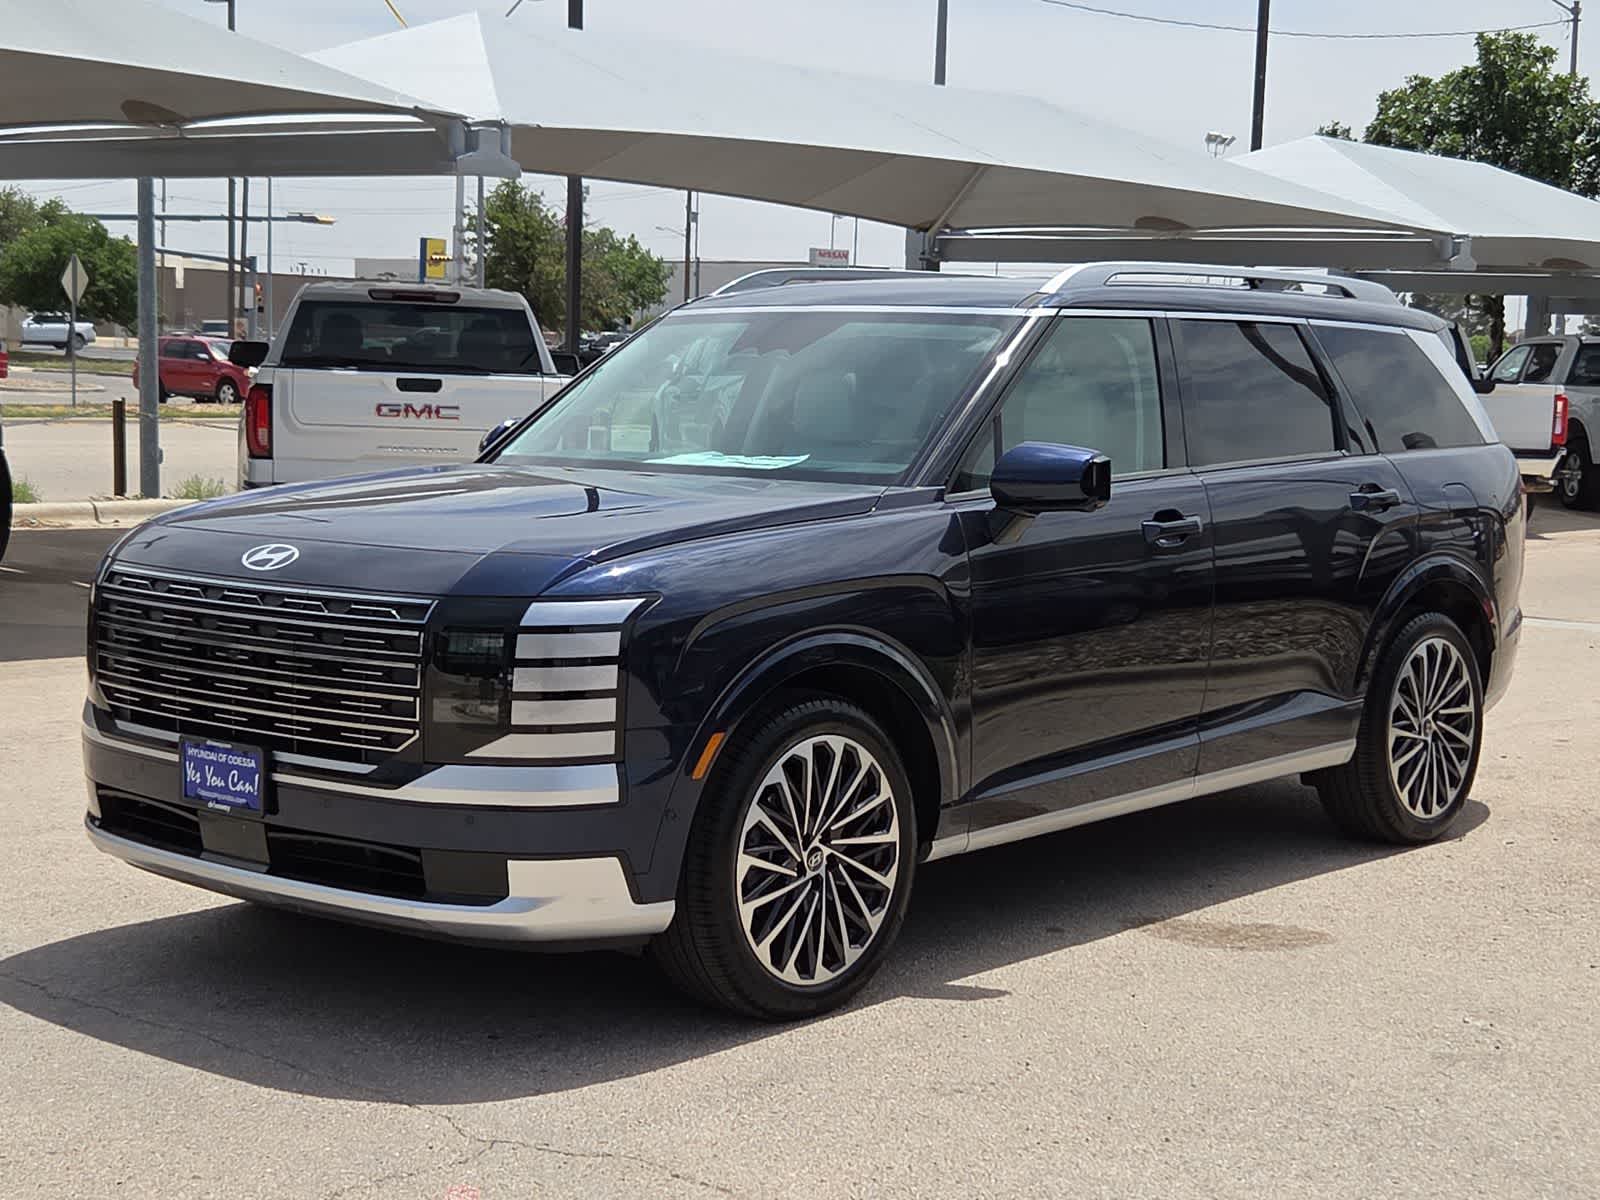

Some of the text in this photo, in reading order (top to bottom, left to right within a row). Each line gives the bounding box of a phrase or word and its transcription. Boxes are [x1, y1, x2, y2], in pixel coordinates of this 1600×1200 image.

[376, 403, 459, 420] GMC
[187, 747, 257, 768] HYUNDAI OF ODESSA
[186, 761, 201, 784] Yes
[205, 765, 225, 787] You
[229, 770, 259, 796] Can!
